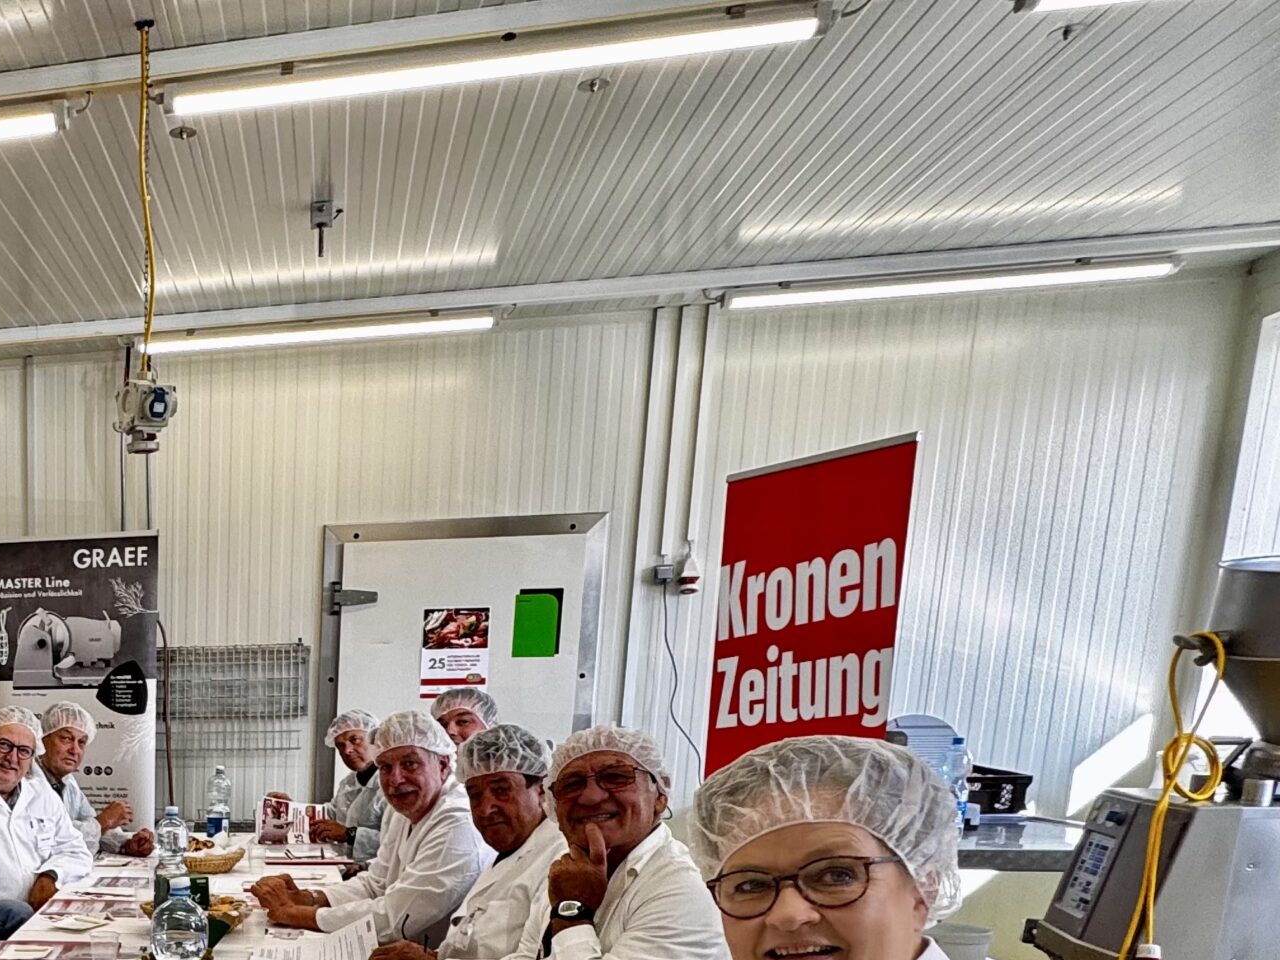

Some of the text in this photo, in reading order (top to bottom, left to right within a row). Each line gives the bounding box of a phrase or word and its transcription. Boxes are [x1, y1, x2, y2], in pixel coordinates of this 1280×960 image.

[45, 576, 70, 588] Line
[23, 590, 36, 598] und
[717, 537, 897, 642] Kronen
[428, 657, 446, 670] 25
[715, 644, 894, 729] Zeitung
